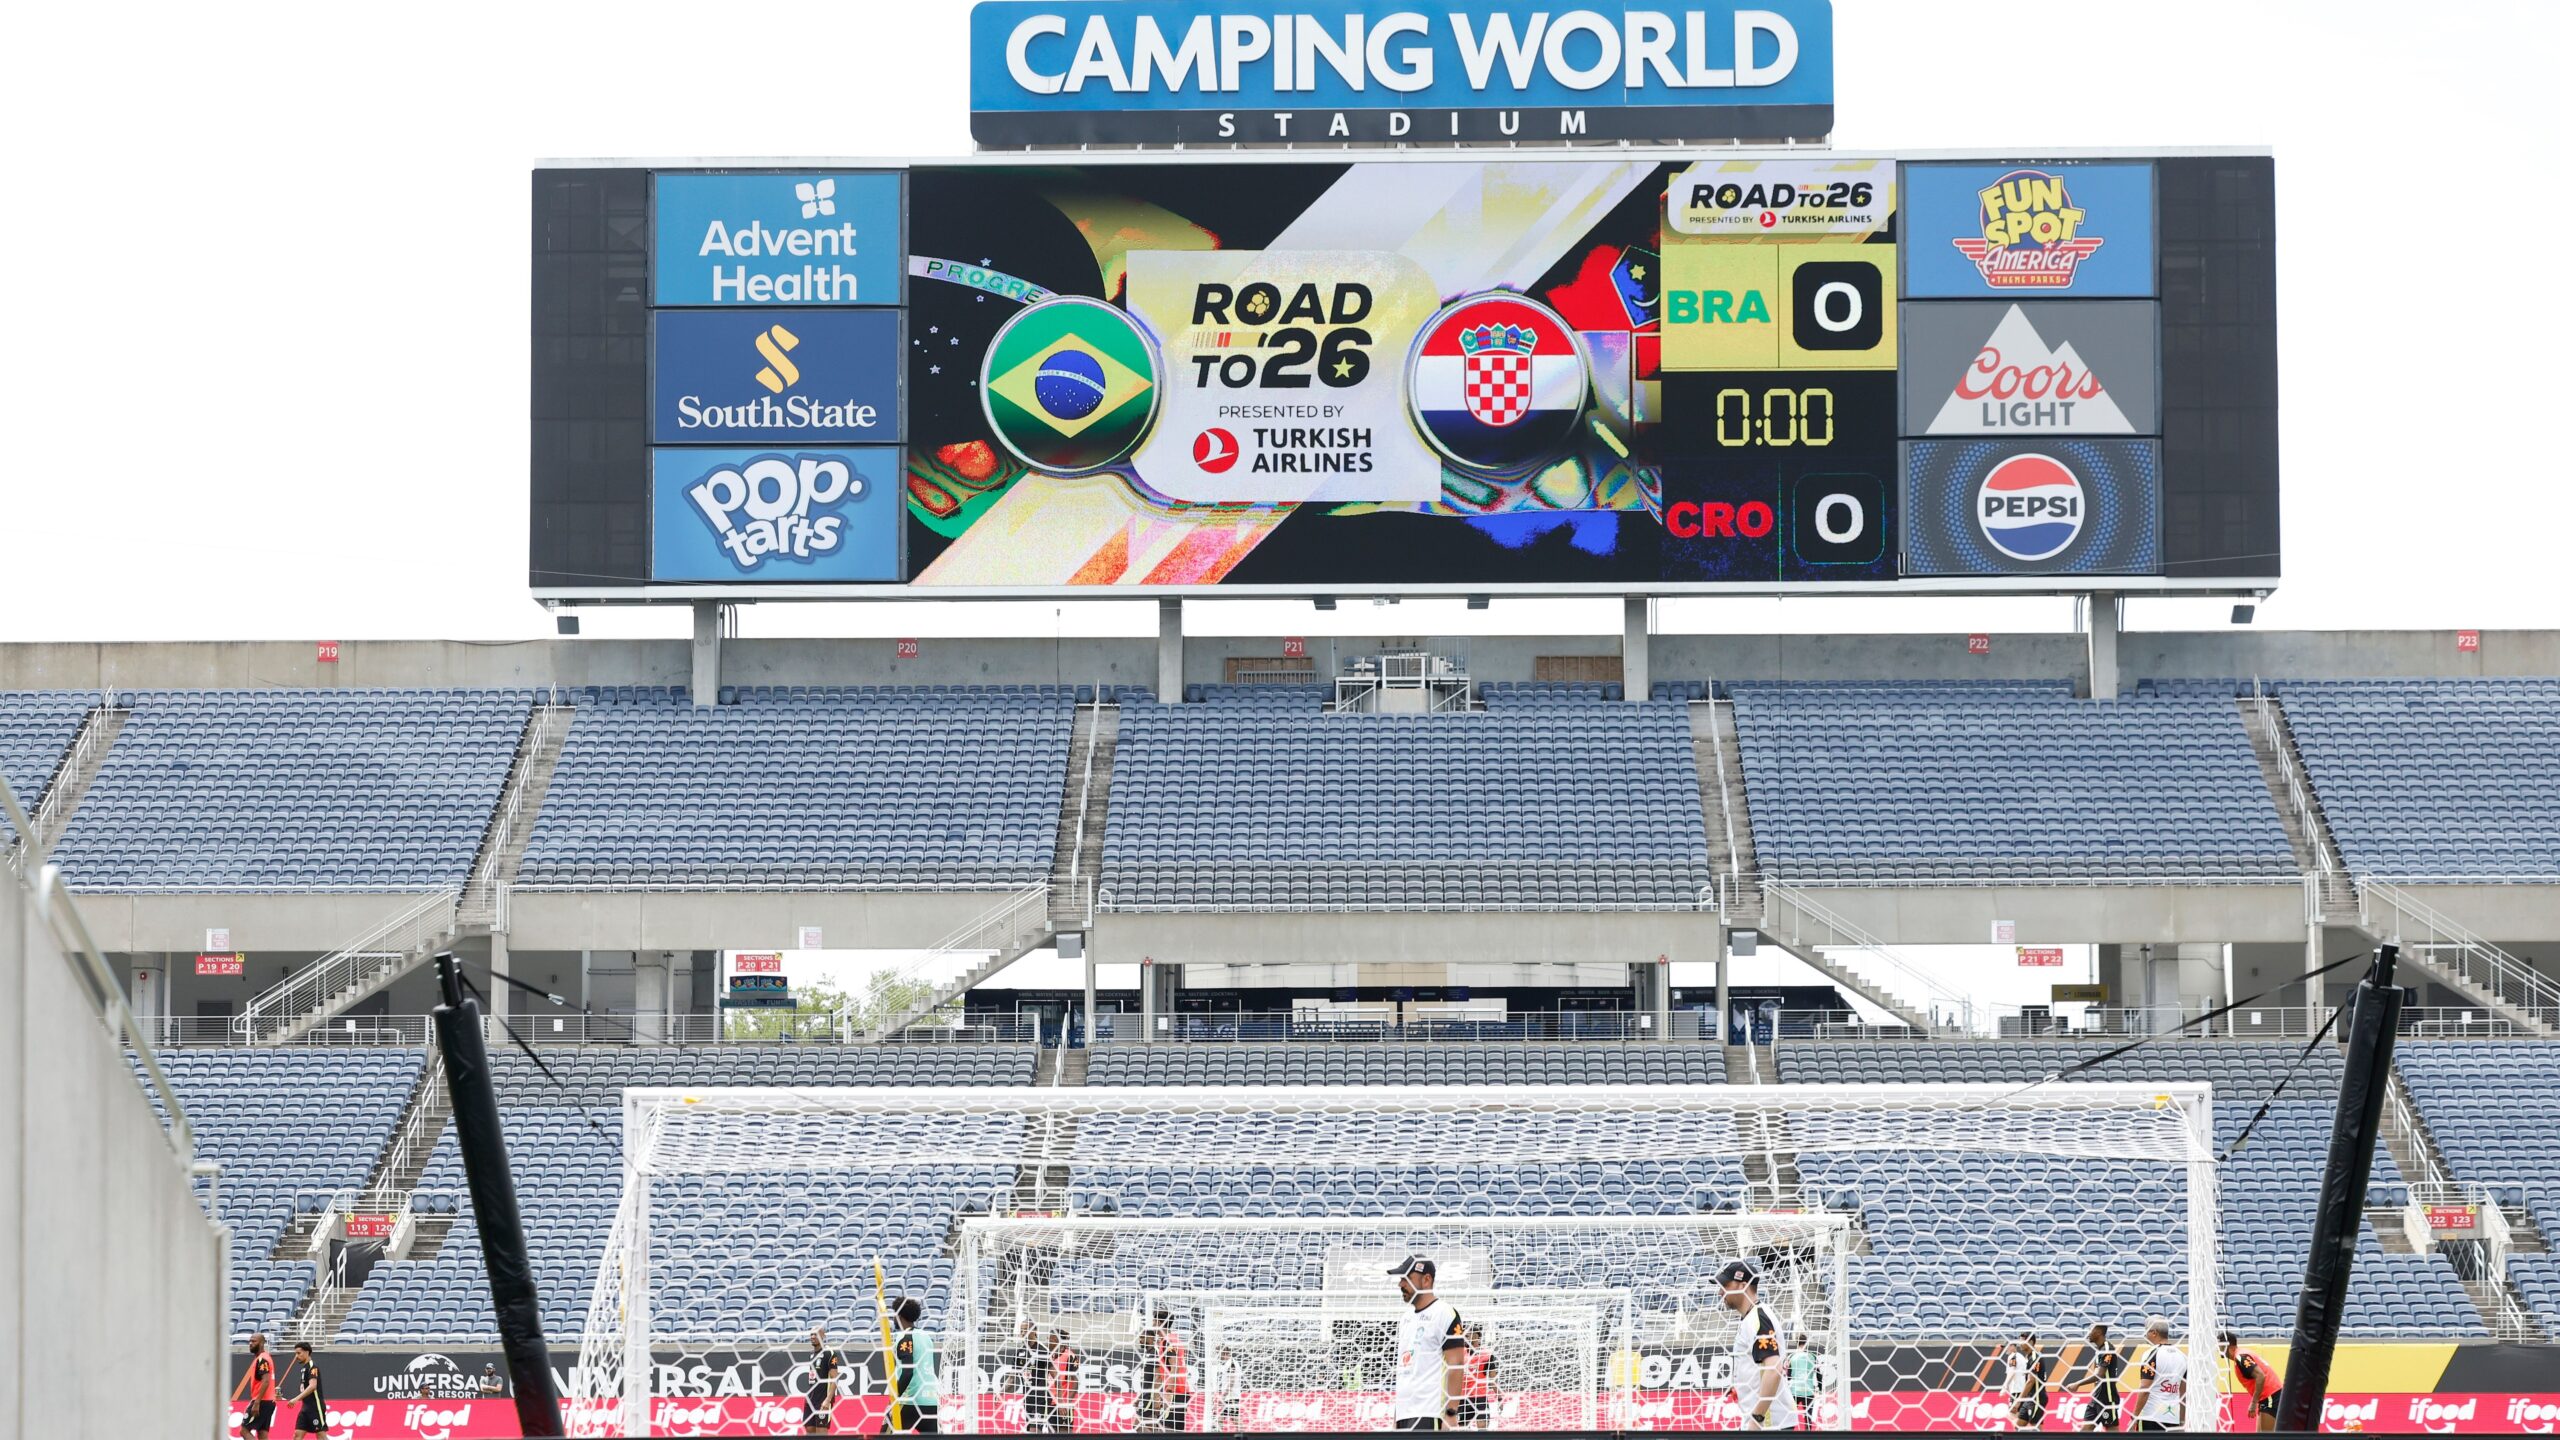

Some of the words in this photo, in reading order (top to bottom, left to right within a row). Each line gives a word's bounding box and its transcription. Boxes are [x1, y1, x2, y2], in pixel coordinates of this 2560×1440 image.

[1006, 12, 1434, 94] CAMPING
[1449, 10, 1799, 90] WORLD
[1218, 111, 1587, 137] STADIUM
[1690, 183, 1796, 209] ROAD
[1798, 193, 1825, 208] TO
[1981, 178, 2063, 222] FUN
[1782, 215, 1824, 224] TURKISH
[1828, 214, 1873, 224] AIRLINES
[1985, 207, 2083, 252] SPOT
[699, 219, 857, 257] Advent
[1980, 245, 2077, 275] AMERICA
[713, 264, 857, 301] Health
[1997, 275, 2026, 284] THEME
[2031, 275, 2061, 284] PARKS
[1192, 282, 1373, 325] ROAD
[1667, 290, 1771, 323] BRA
[1192, 355, 1256, 388] TO
[1954, 346, 2104, 400] Coors
[677, 395, 877, 428] SouthState
[1219, 406, 1318, 419] PRESENTED
[1323, 406, 1344, 419] BY
[1717, 388, 1833, 446] 0:00
[1982, 401, 2076, 426] LIGHT
[1254, 428, 1373, 449] TURKISH
[1251, 452, 1373, 474] AIRLINES
[1666, 501, 1774, 538] CRO
[1984, 496, 2078, 518] PEPSI
[723, 513, 842, 567] tarts
[318, 646, 338, 658] P19
[898, 642, 917, 654] P20
[1285, 641, 1303, 652] P21
[1969, 638, 1989, 649] P22
[2458, 635, 2478, 647] P23
[374, 1373, 481, 1393] UNIVERSA
[1605, 1354, 1734, 1389] OAD
[438, 1390, 478, 1399] RESORT
[324, 1405, 374, 1428] ood
[404, 1404, 471, 1431] ifood
[656, 1402, 722, 1429] ifood
[753, 1401, 803, 1428] ifoo
[1102, 1397, 1137, 1424] ifo
[1705, 1395, 1744, 1423] ifo
[1960, 1396, 2012, 1424] ifoo
[2319, 1398, 2378, 1424] food
[2408, 1397, 2477, 1424] ifood
[2506, 1398, 2560, 1424] ifoo
